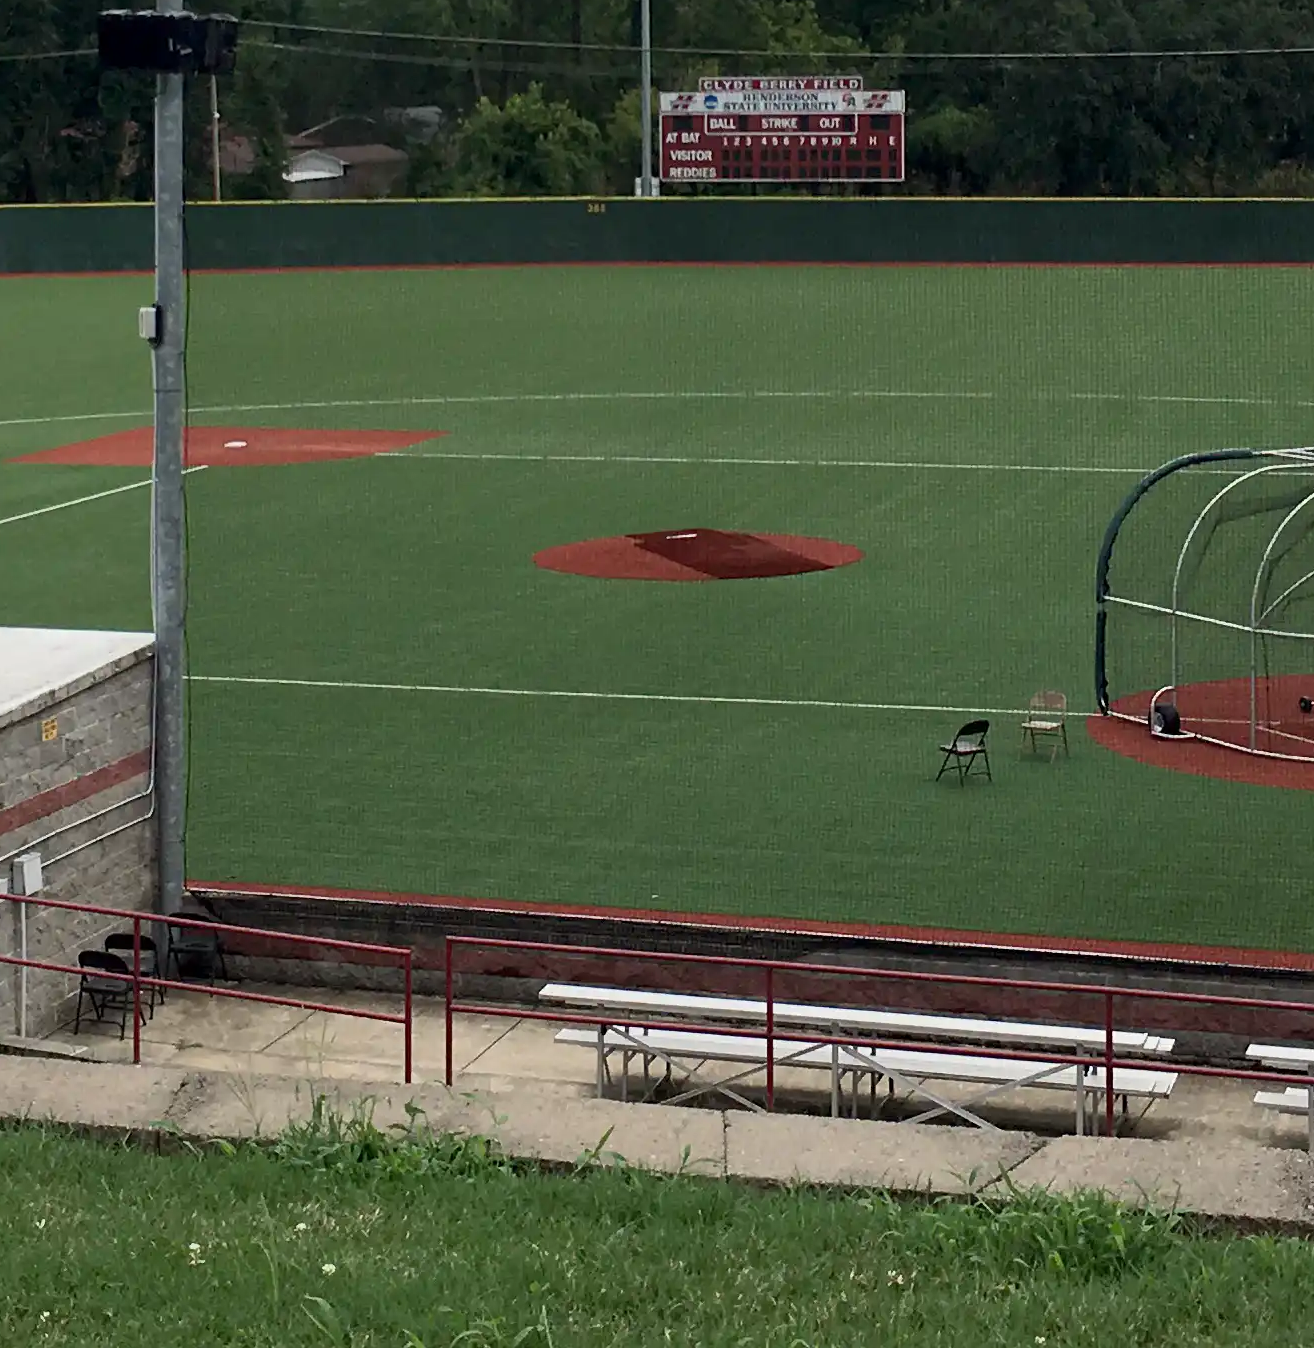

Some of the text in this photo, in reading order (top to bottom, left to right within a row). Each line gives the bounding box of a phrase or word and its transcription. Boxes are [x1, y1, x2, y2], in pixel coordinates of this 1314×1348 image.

[703, 79, 860, 90] CLYDE BERRY FIELD
[743, 93, 819, 102] HENDERSON
[723, 102, 758, 111] STATE
[763, 102, 838, 111] UNIVERSITY
[709, 118, 736, 129] BALL
[761, 118, 798, 129] STRIKE
[819, 118, 840, 129] OUT
[666, 132, 700, 143] AT BAT
[723, 137, 728, 146] 1
[734, 137, 740, 146] 2
[746, 137, 752, 146] 3
[761, 137, 767, 145] 4
[772, 137, 778, 146] 5
[783, 136, 790, 146] 6
[799, 136, 805, 146] 7
[810, 136, 817, 146] 8
[822, 136, 828, 146] 9
[831, 136, 842, 146] 10
[869, 136, 877, 145] H
[889, 136, 896, 146] E
[670, 150, 713, 161] VISITOR
[669, 167, 716, 178] REDDIES
